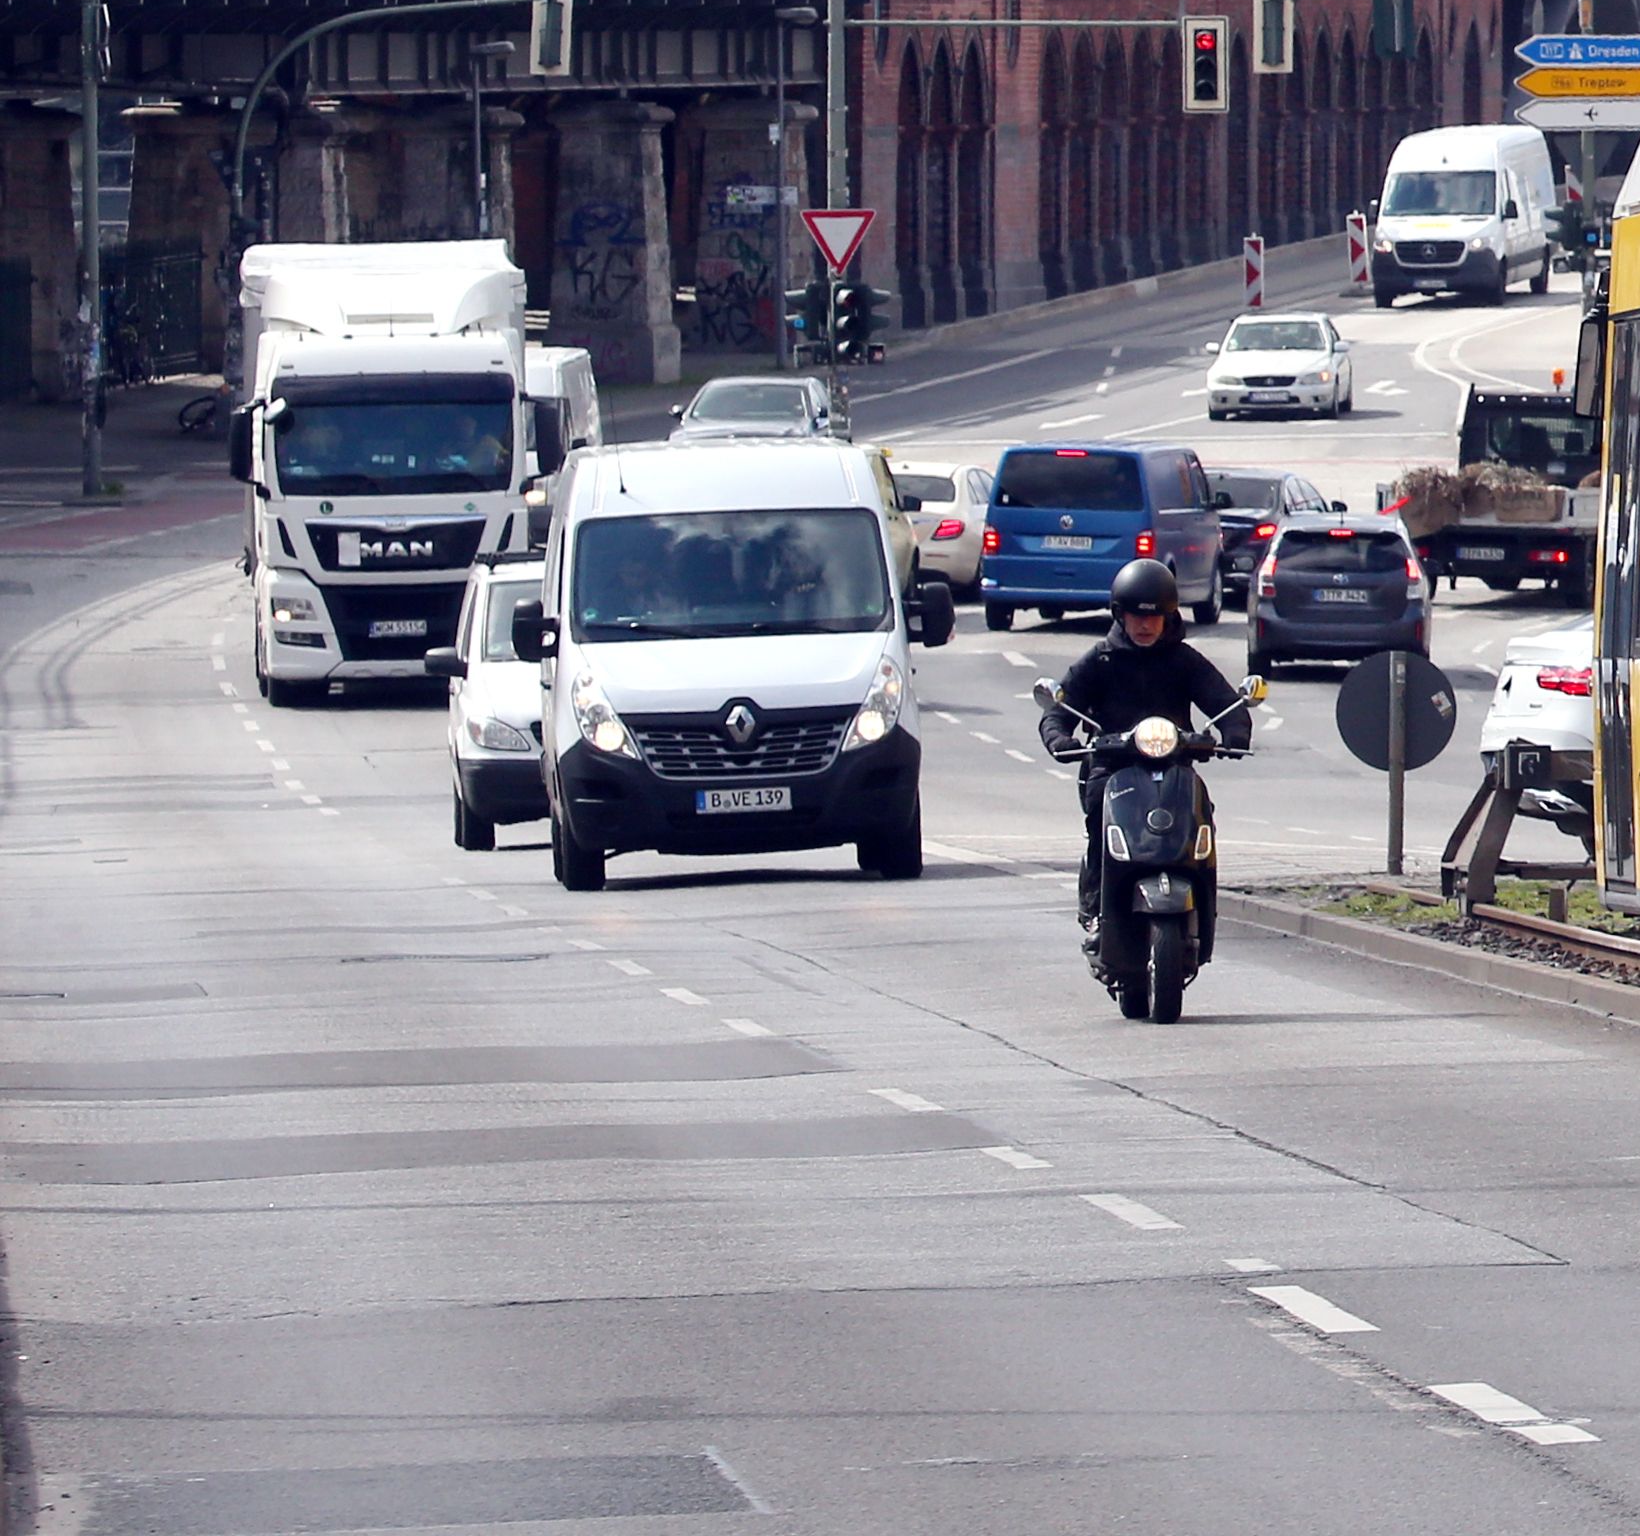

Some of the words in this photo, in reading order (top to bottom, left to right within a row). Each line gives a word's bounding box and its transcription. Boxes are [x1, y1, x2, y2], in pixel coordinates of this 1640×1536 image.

[1588, 45, 1639, 57] Dresden
[1579, 77, 1626, 88] Treptow
[360, 541, 433, 557] MAN
[711, 793, 721, 807] B
[732, 791, 751, 806] VE
[755, 790, 783, 805] 139
